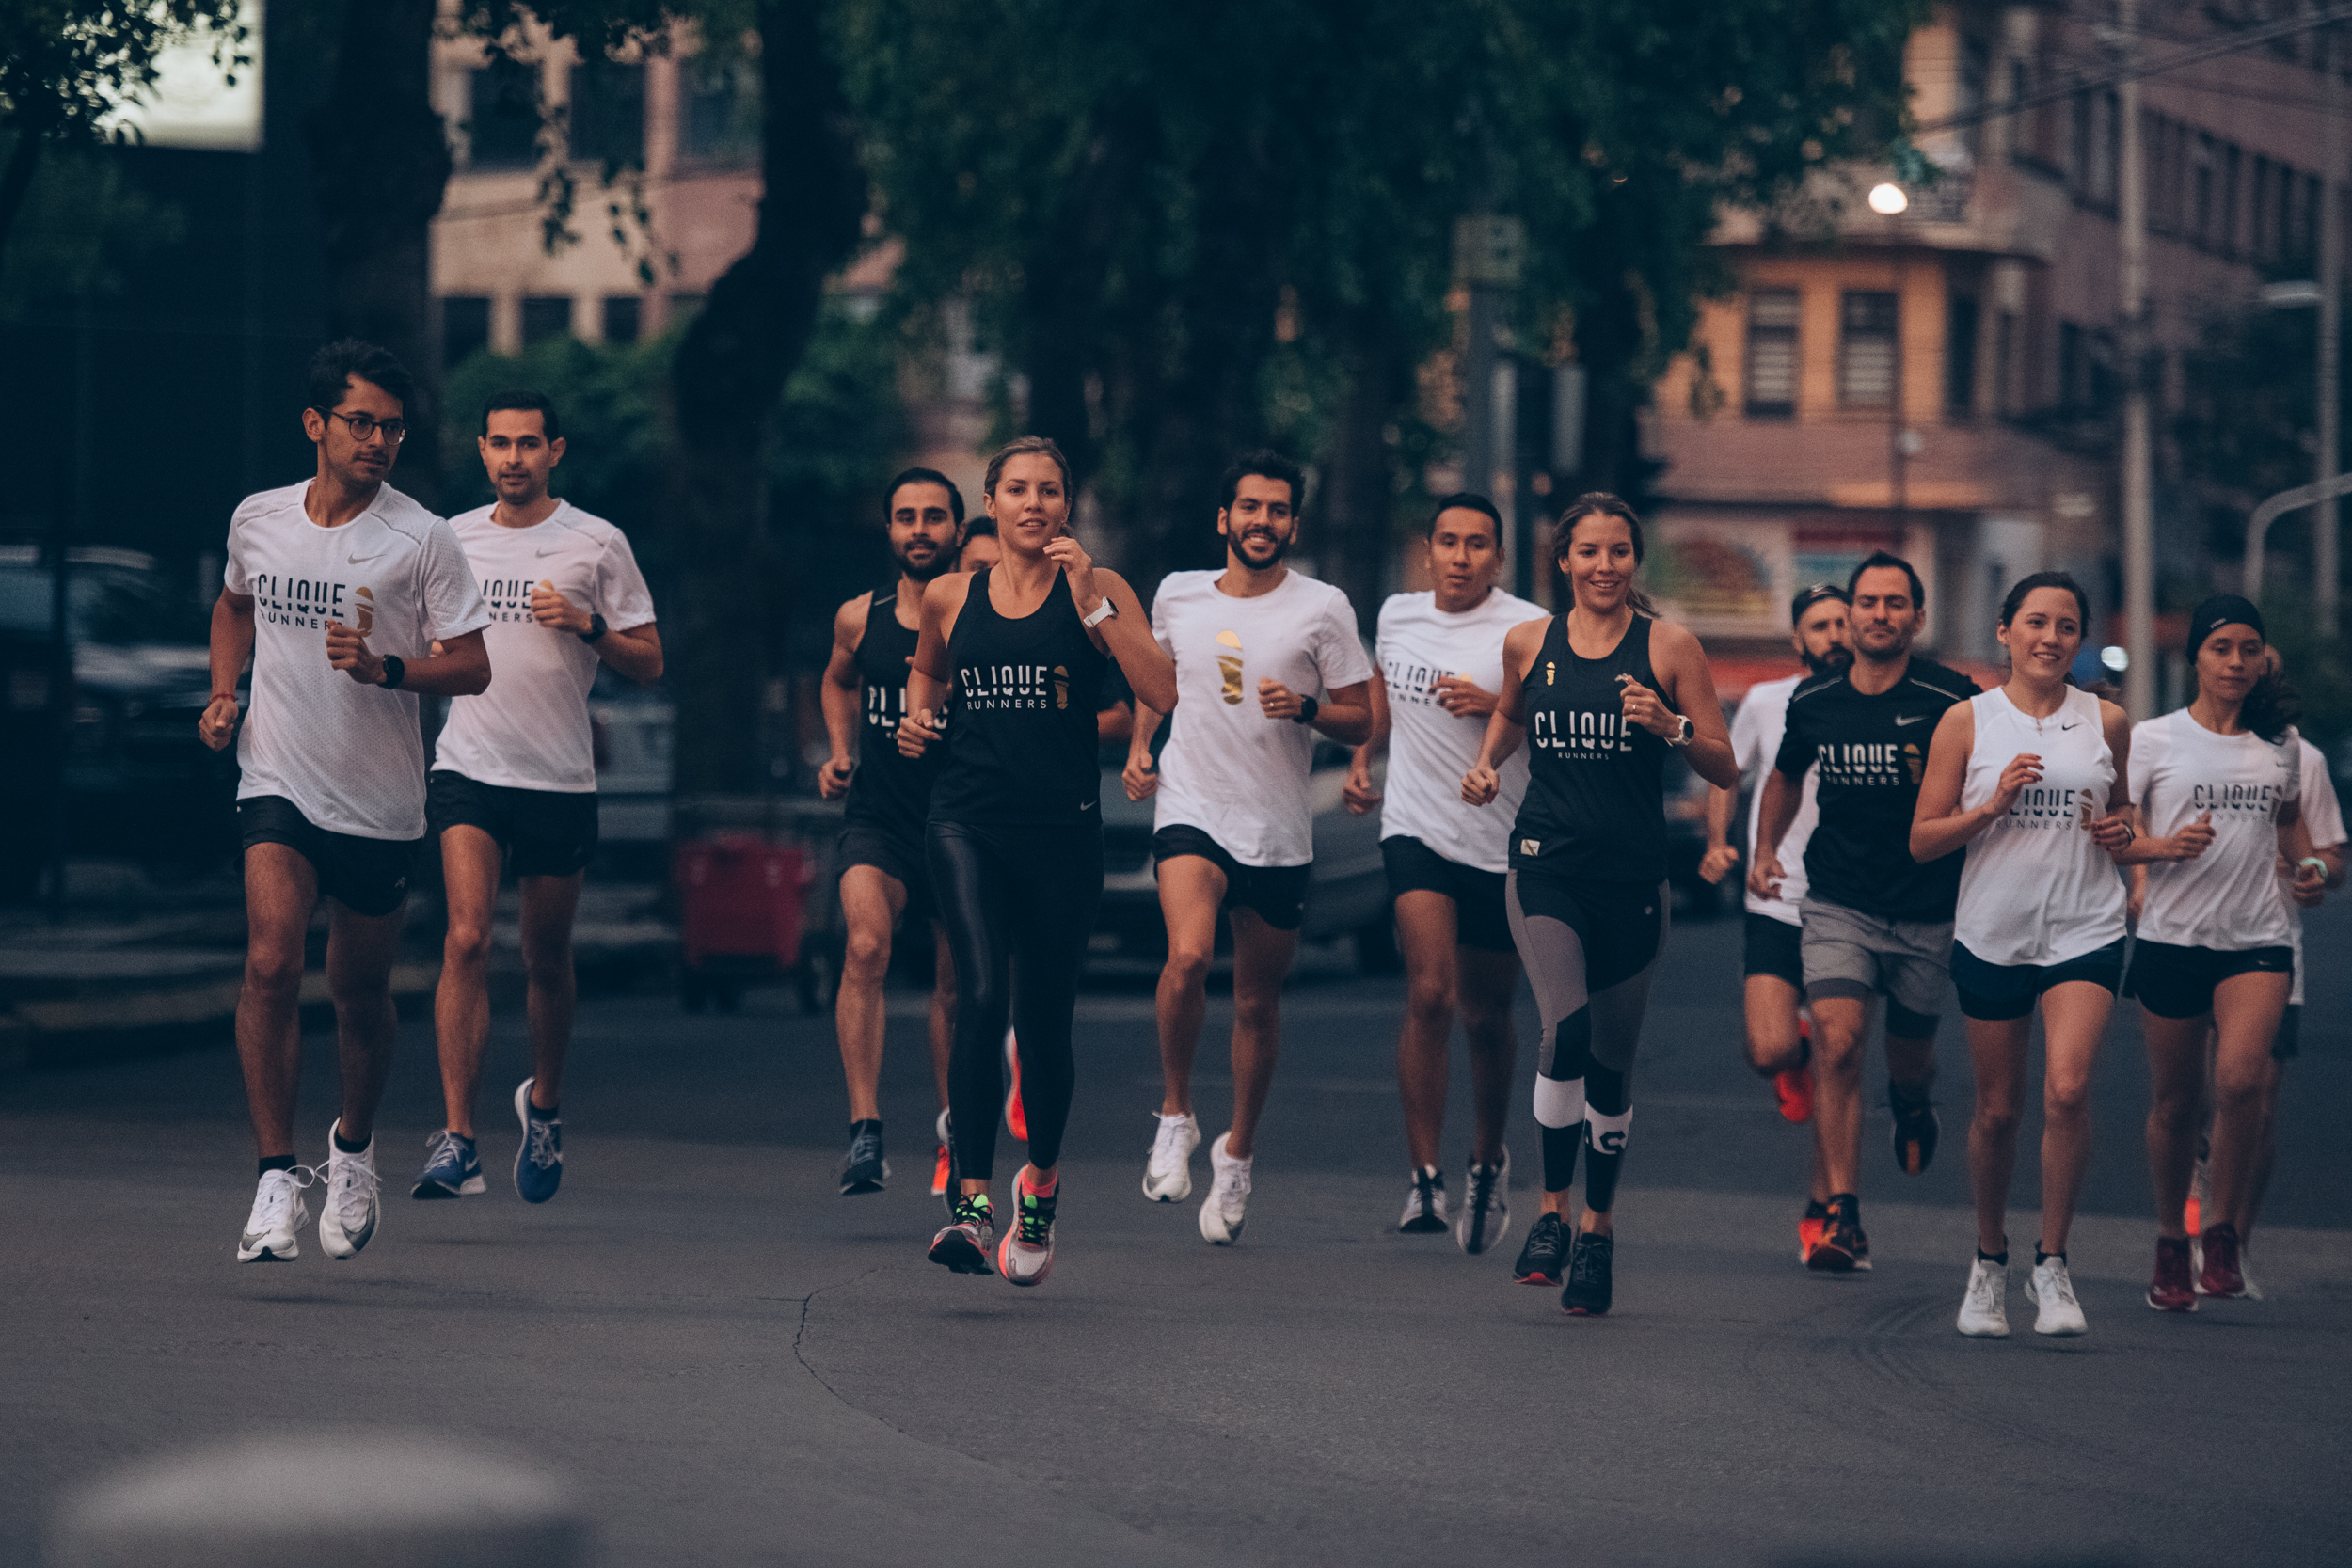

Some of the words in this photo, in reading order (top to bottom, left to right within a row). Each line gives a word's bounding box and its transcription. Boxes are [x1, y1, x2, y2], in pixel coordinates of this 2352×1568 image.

[258, 573, 346, 619] CLIQUE
[483, 579, 534, 610] IQUE
[260, 610, 343, 632] UNNER
[489, 611, 533, 624] NERS
[961, 664, 1048, 698] CLIQUE
[966, 699, 1048, 711] RUNNERS
[1534, 710, 1633, 752] CLIQUE
[1557, 752, 1610, 761] RUNNERS
[1817, 743, 1899, 775] CLIQUE
[2194, 784, 2273, 813] CLIQUE
[1995, 818, 2074, 831] RUNNERS
